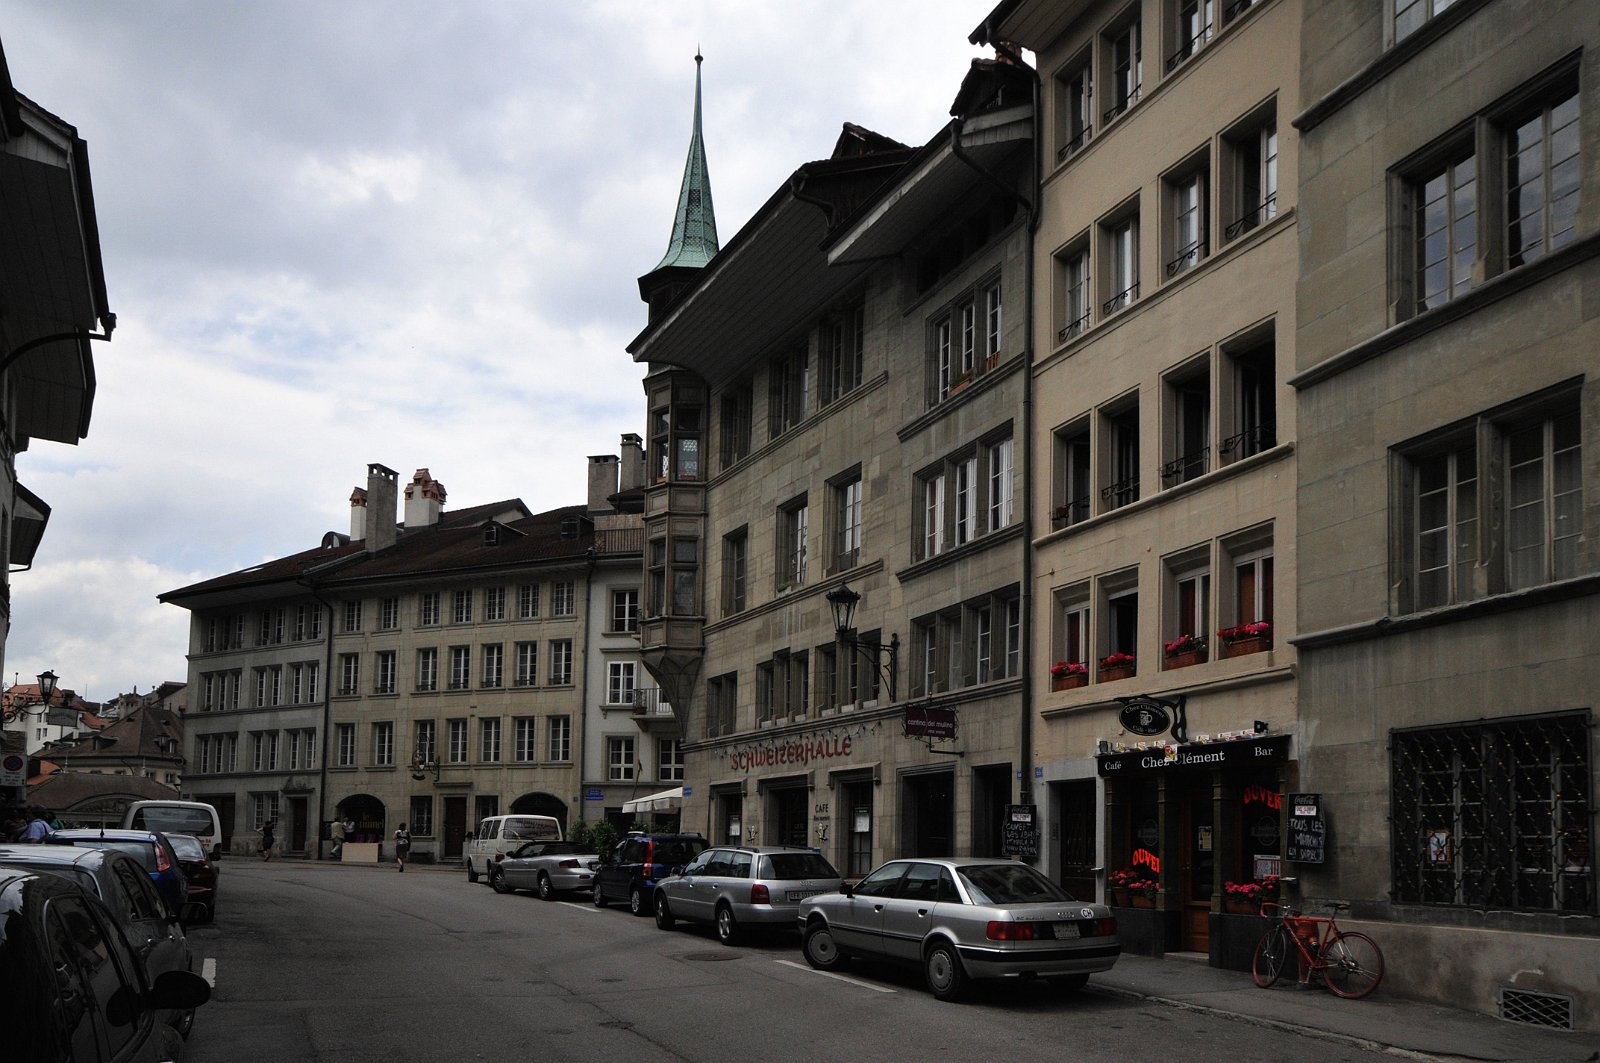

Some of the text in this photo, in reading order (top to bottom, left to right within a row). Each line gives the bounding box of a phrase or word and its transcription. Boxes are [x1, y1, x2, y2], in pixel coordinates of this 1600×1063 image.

[731, 737, 852, 773] SCHWEIZERHALLE
[1105, 761, 1122, 771] Café
[1174, 750, 1226, 766] Clément
[1254, 746, 1273, 759] Bar
[1290, 818, 1308, 832] TOUS
[1082, 908, 1094, 918] CH
